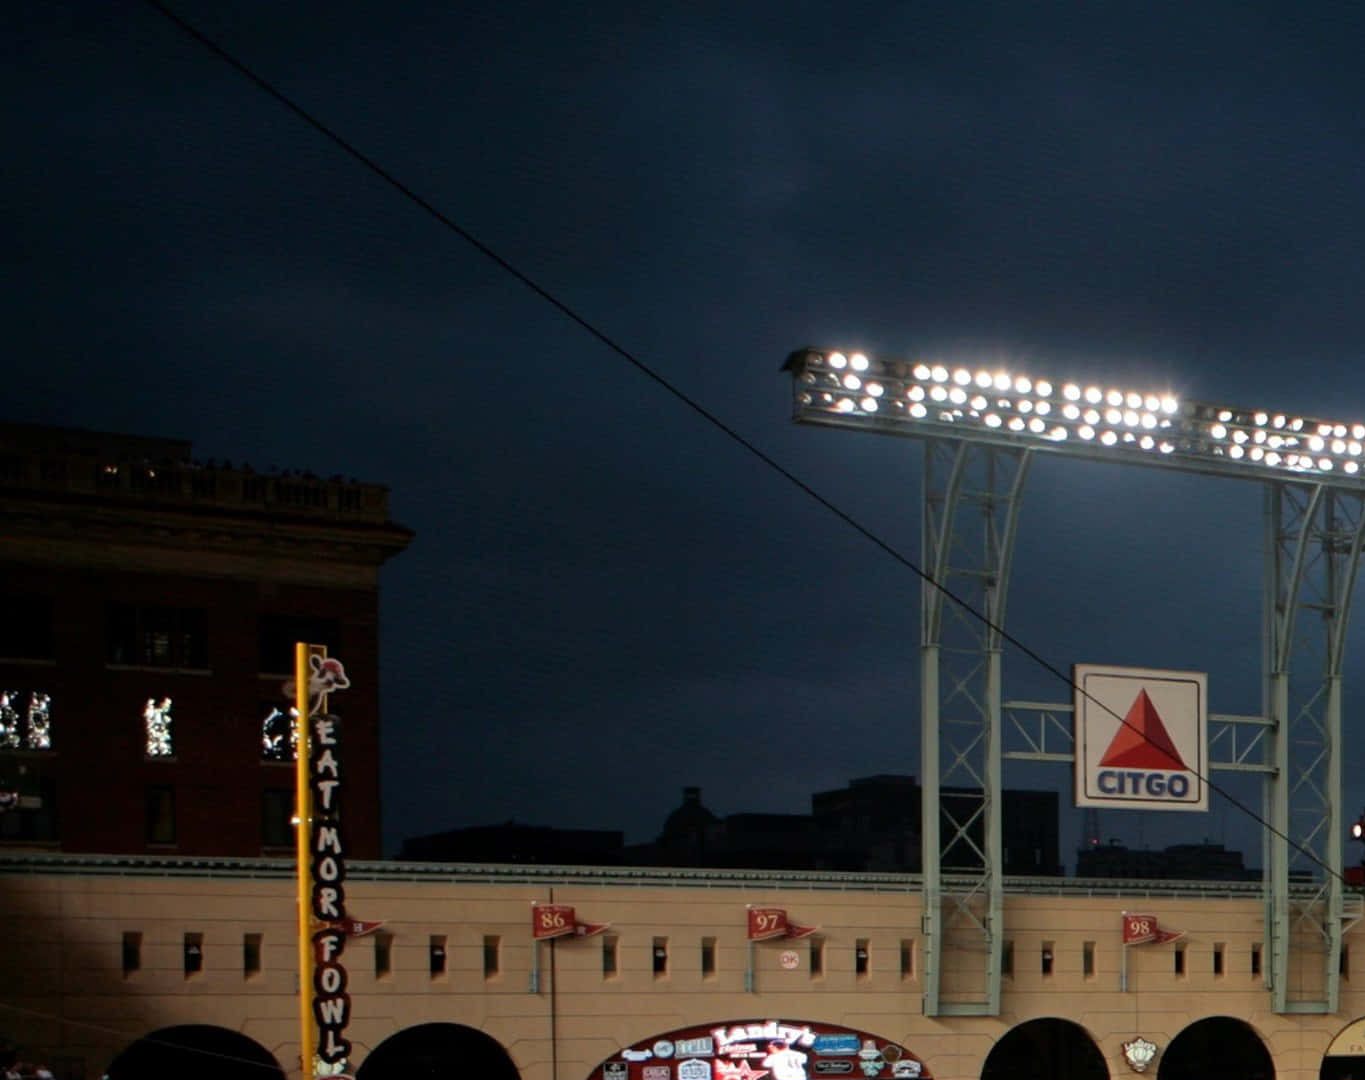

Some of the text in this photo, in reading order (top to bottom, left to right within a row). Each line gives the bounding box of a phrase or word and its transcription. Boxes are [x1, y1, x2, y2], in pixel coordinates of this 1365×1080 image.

[1097, 770, 1189, 798] CITGO
[315, 719, 345, 1056] EAT MOR FOWL
[541, 912, 566, 928] 86
[756, 914, 778, 930] 97
[1131, 920, 1150, 935] 98
[711, 1020, 818, 1048] Landry's
